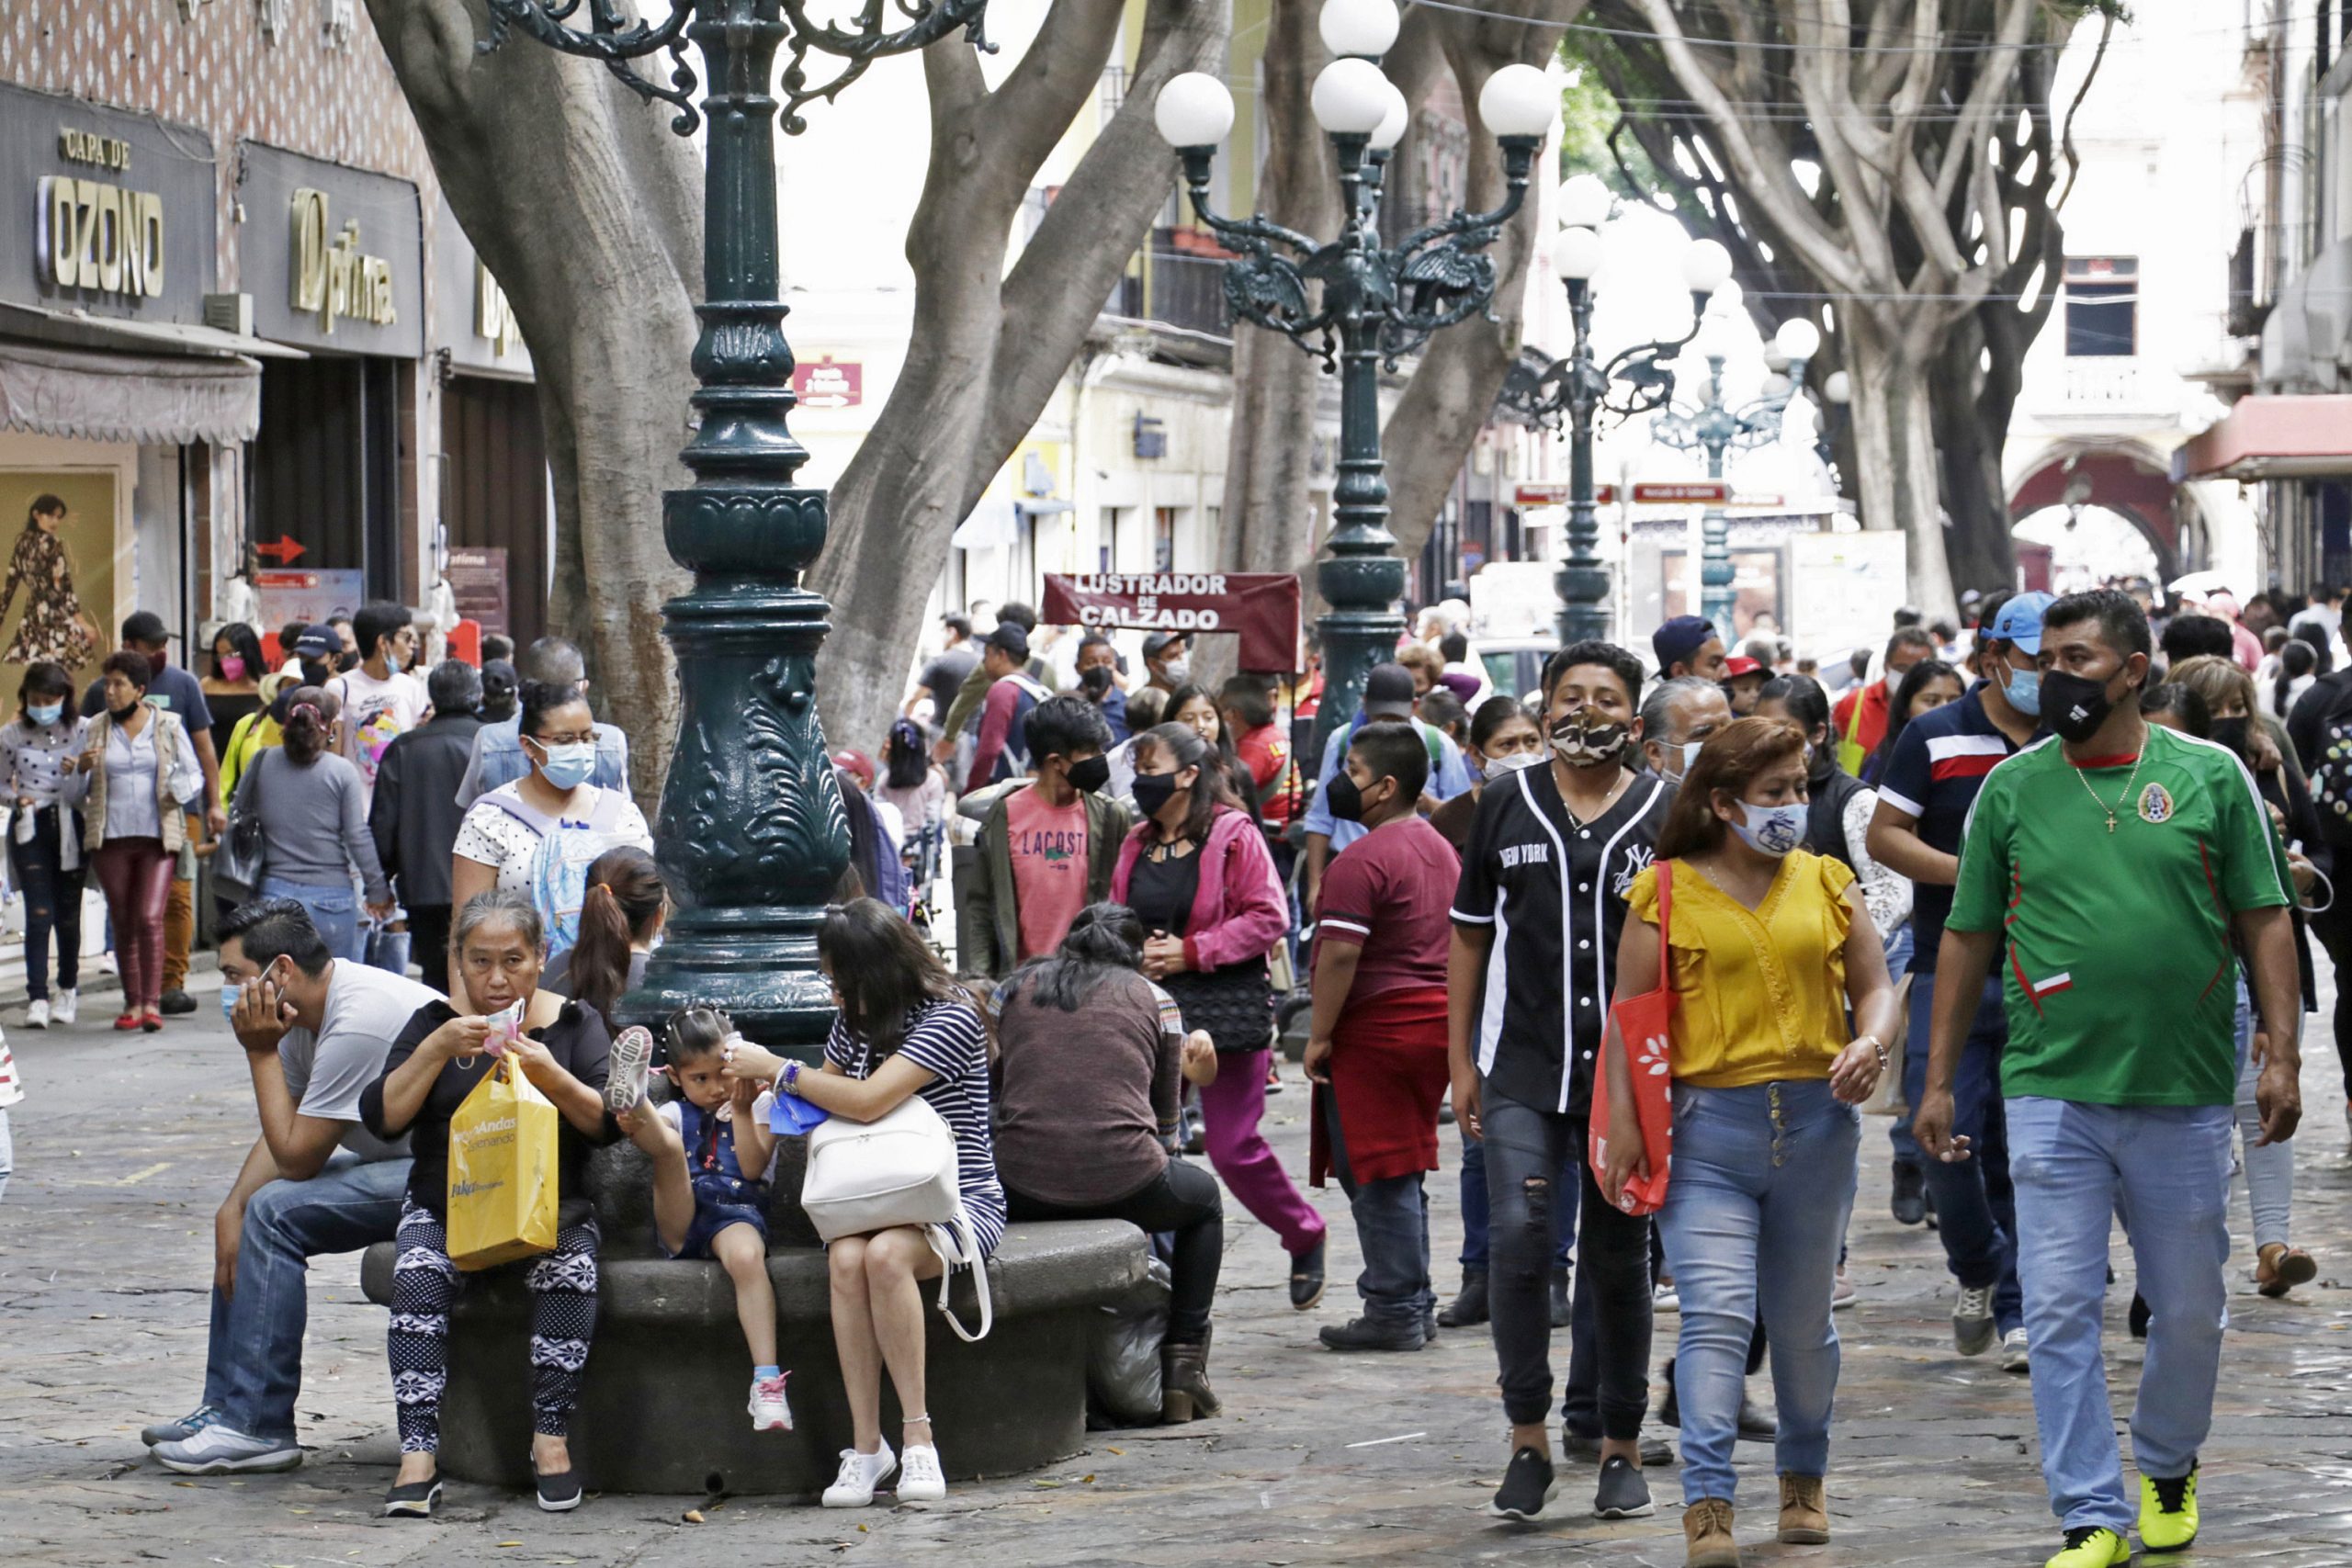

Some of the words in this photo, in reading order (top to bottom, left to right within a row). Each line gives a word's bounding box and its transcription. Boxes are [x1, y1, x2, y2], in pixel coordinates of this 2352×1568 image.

[62, 128, 106, 165] CAPA
[110, 139, 130, 170] DE
[40, 175, 164, 298] OZONO
[1073, 574, 1227, 595] LUSTRADOR
[1137, 595, 1158, 609] DE
[1079, 605, 1220, 630] CALZADO
[1023, 830, 1088, 856] LACOST
[1498, 845, 1520, 869] NEW
[1521, 843, 1548, 863] YORK
